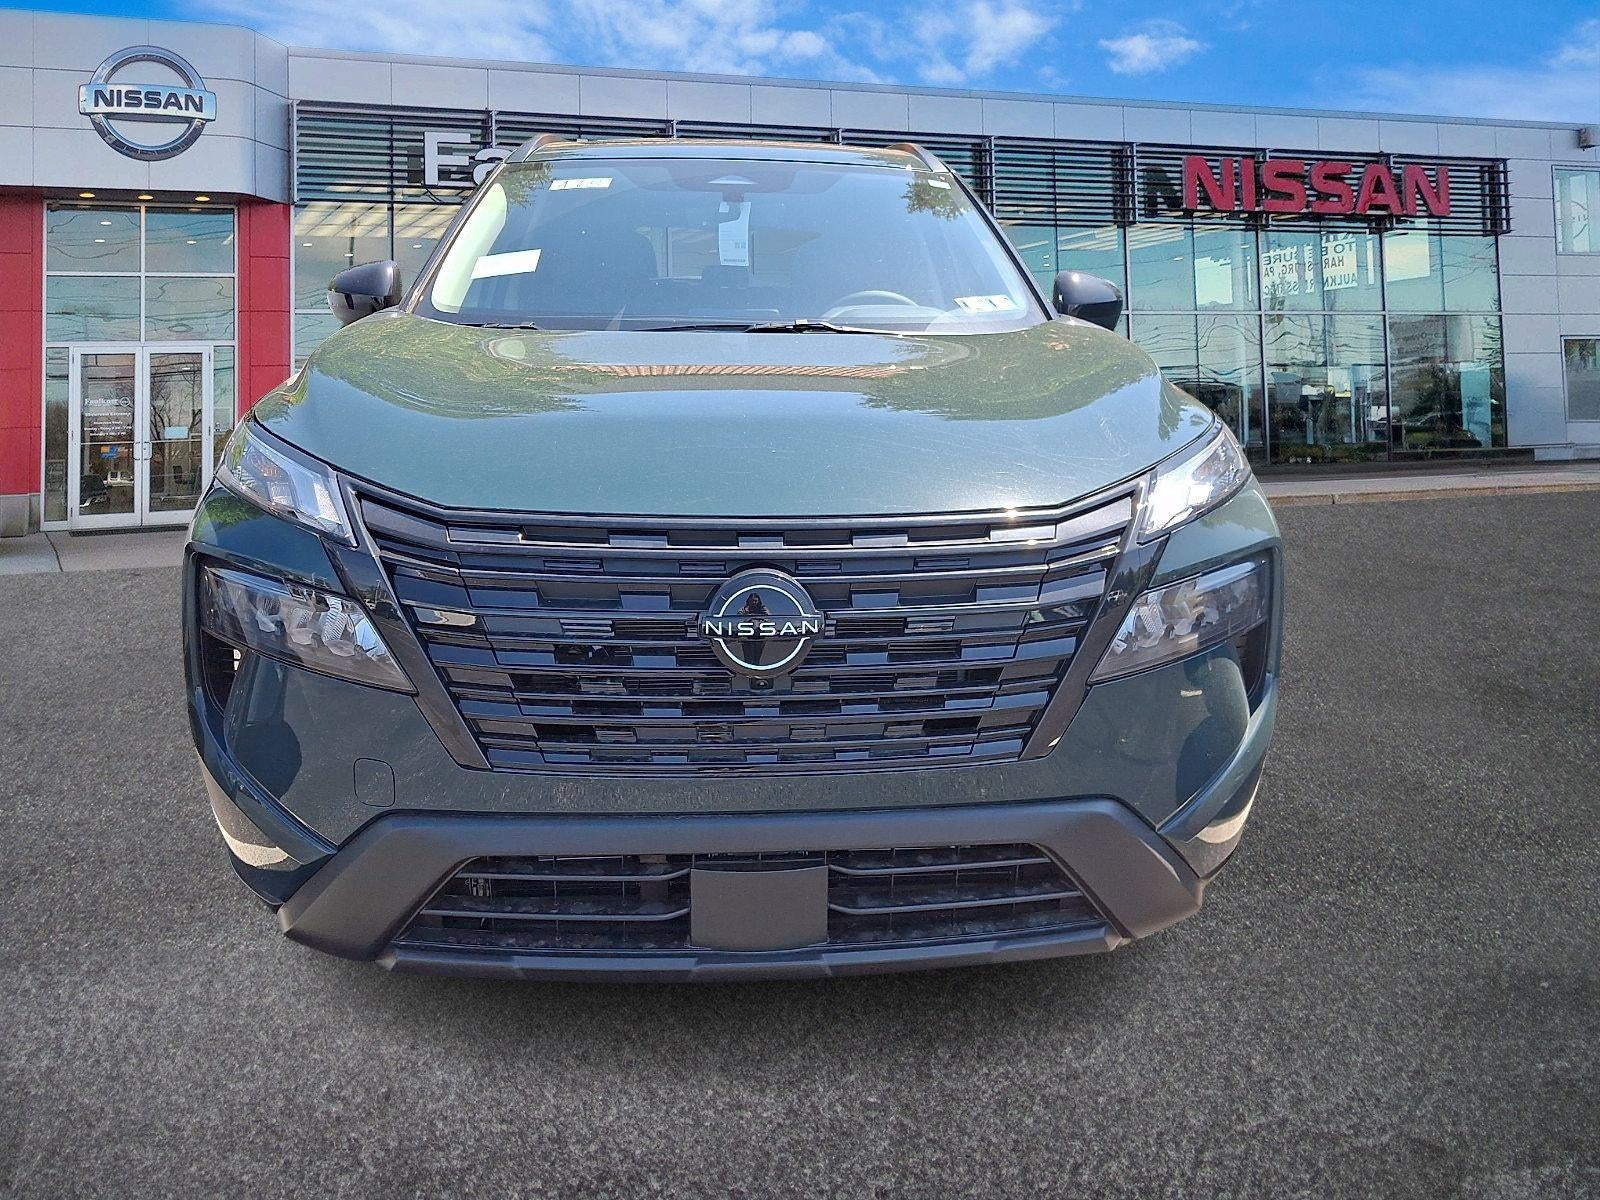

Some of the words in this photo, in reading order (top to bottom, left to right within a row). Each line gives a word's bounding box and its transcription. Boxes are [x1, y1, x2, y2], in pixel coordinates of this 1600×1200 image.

[94, 89, 203, 113] NISSAN
[1183, 155, 1450, 216] NISSAN
[705, 620, 818, 636] NISSAN
